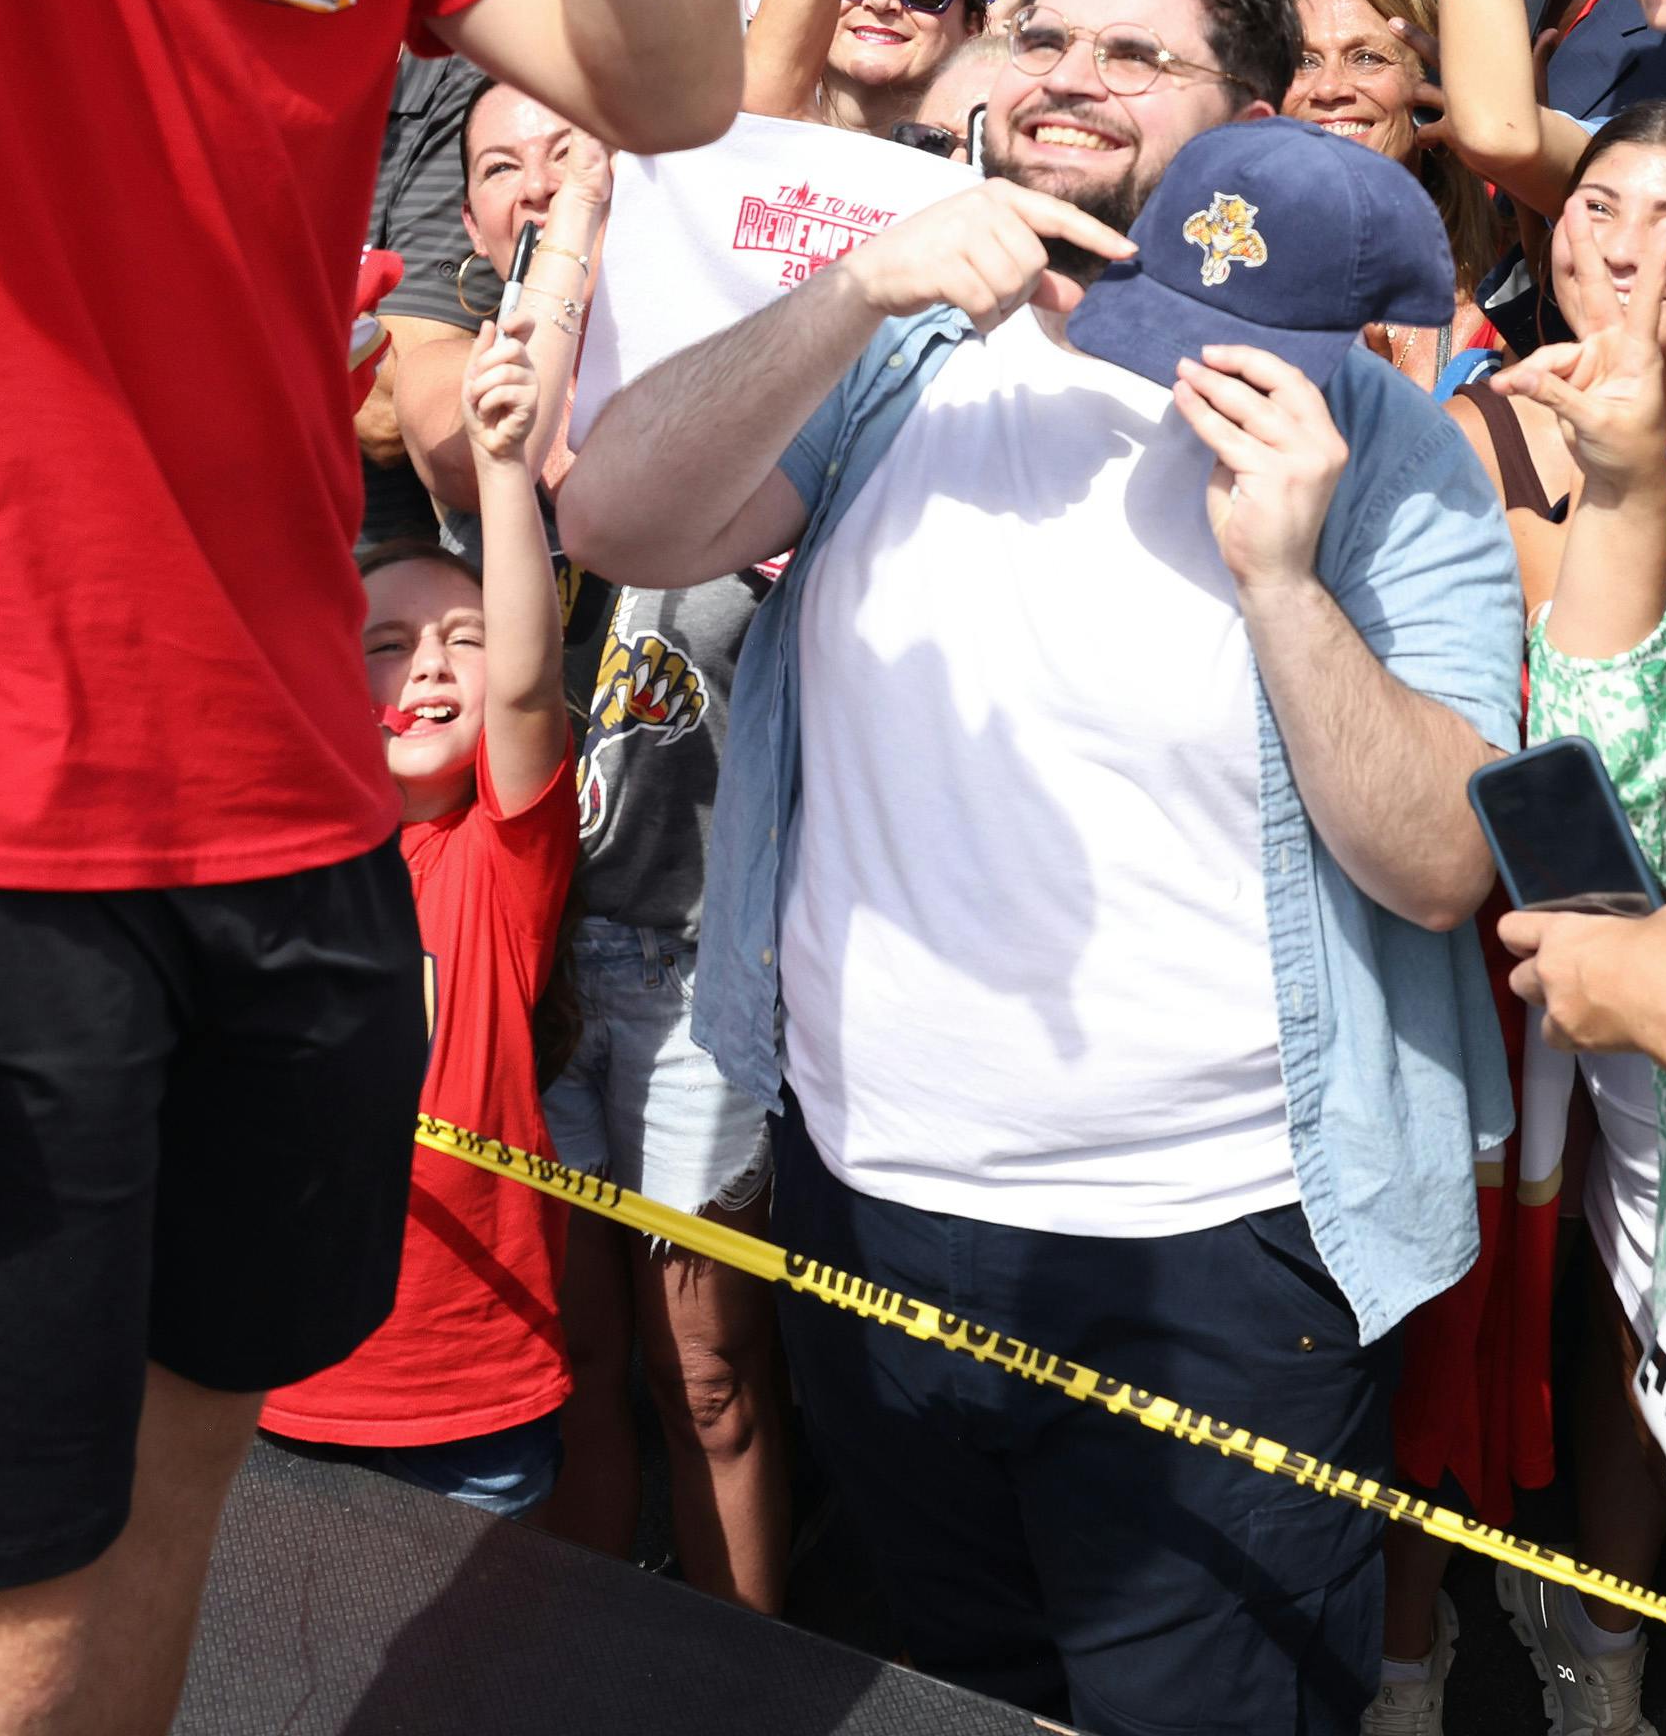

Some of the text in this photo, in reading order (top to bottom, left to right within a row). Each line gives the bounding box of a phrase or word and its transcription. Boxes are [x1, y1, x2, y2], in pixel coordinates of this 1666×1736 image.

[777, 184, 897, 227] TIME TO HUNT
